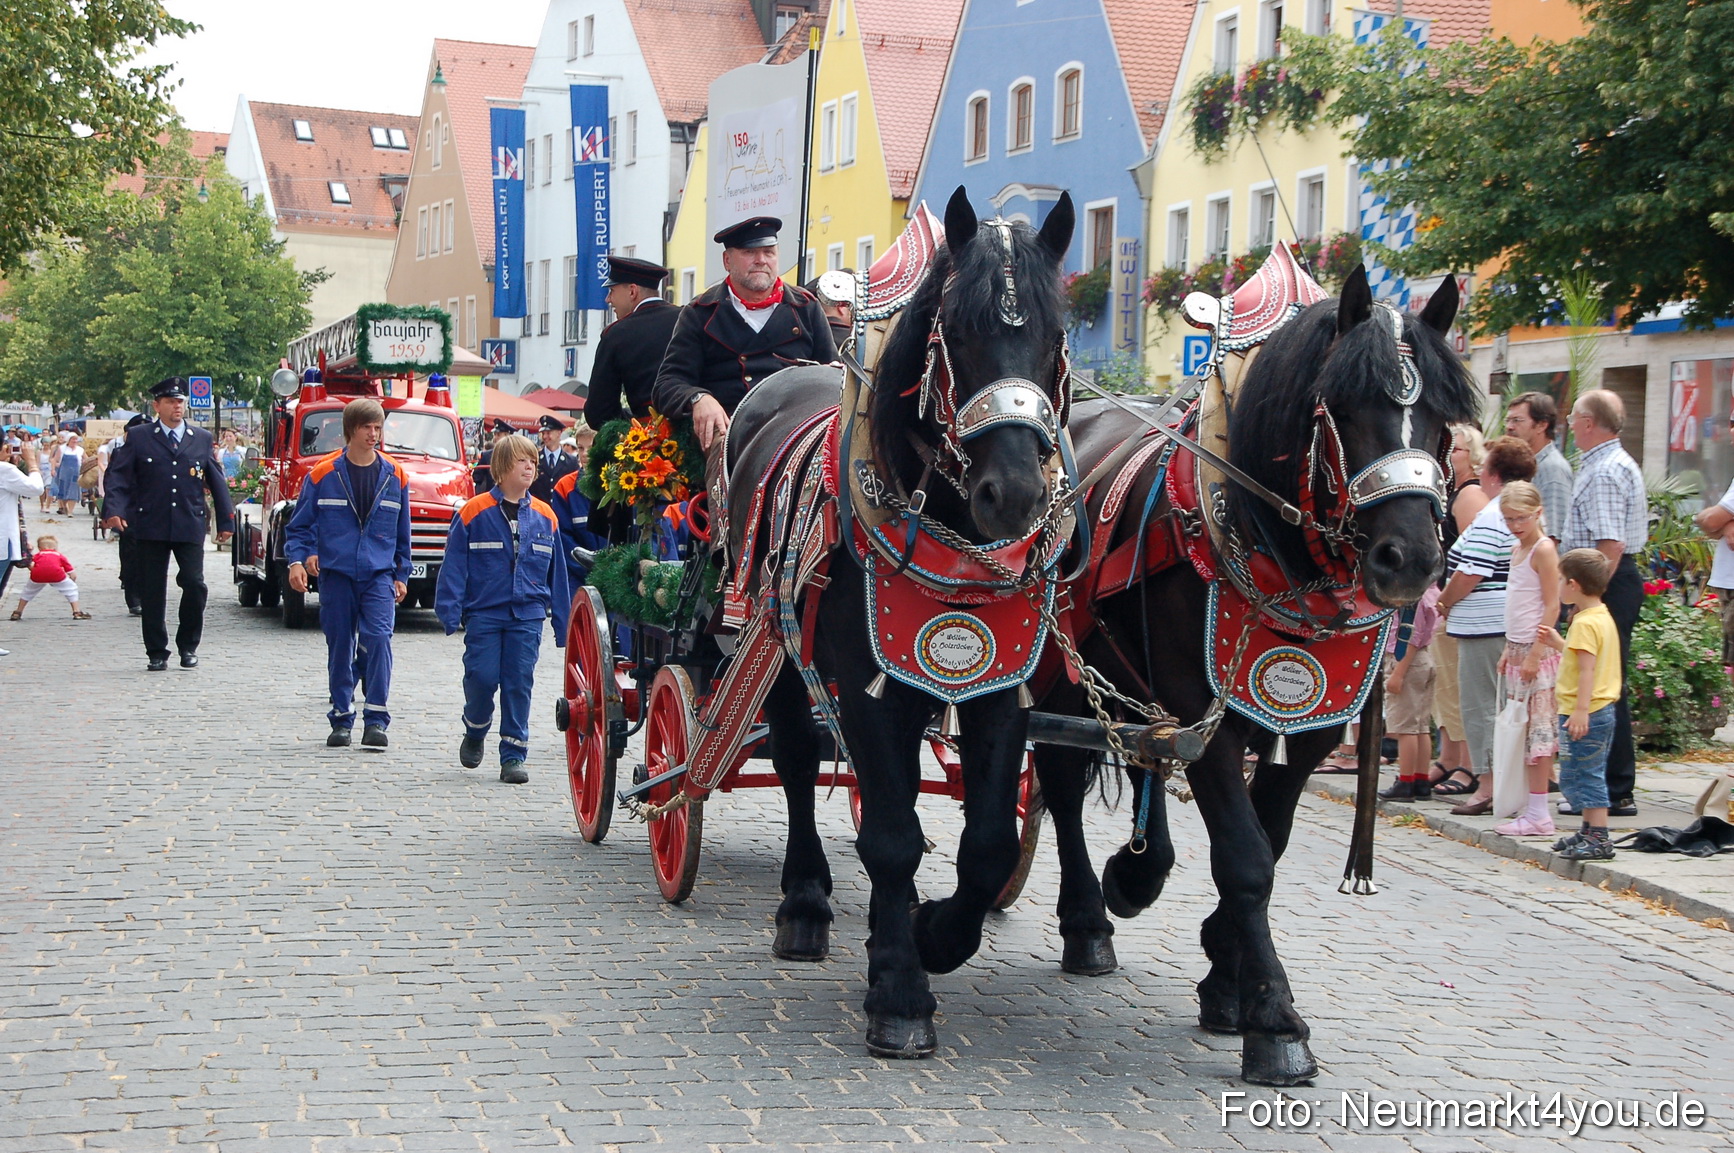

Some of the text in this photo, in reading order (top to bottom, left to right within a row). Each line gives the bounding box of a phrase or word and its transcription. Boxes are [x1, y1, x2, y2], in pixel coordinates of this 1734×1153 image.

[733, 132, 749, 147] 150
[594, 168, 610, 281] K&L RUPPERT
[1120, 260, 1136, 342] WITTL
[389, 343, 426, 358] 1959
[1188, 339, 1208, 372] P
[191, 397, 210, 406] TAXI
